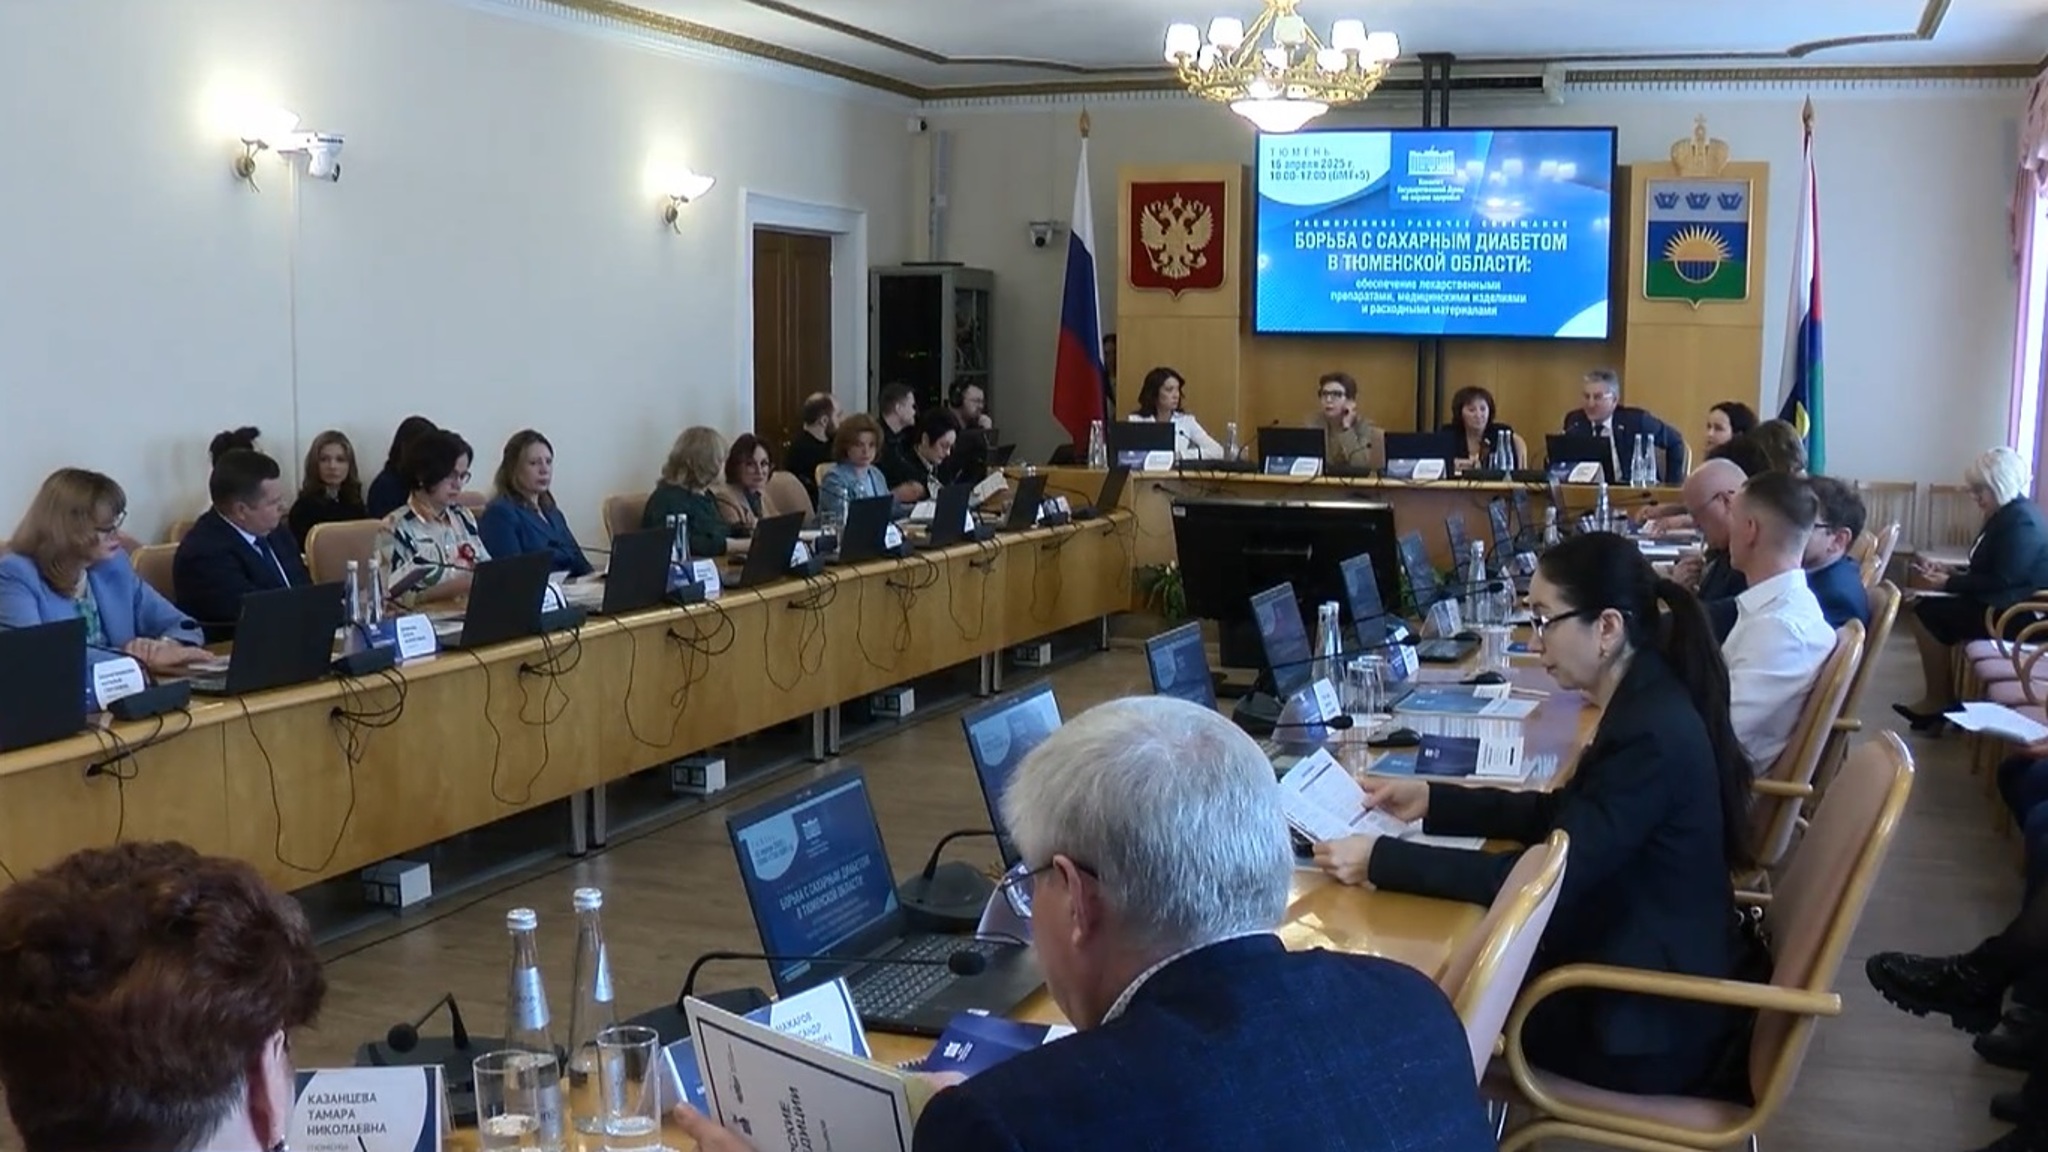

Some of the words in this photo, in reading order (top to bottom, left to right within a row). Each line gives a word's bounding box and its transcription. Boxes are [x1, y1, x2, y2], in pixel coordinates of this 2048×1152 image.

[1320, 158, 1345, 169] 2025
[1295, 231, 1357, 249] БОРЬБА
[1362, 231, 1372, 249] С
[1377, 231, 1470, 250] САХАРНЫМ
[1475, 232, 1568, 252] ДИАБЕТОМ
[1328, 254, 1339, 271] В
[1342, 250, 1446, 272] ТЮМЕНСКОЙ
[1451, 254, 1532, 273] ОБЛАСТИ:
[1356, 278, 1417, 289] обеспечение
[1419, 280, 1501, 291] лекарственными
[1398, 292, 1470, 304] медицинскими
[1472, 293, 1528, 305] изделиями
[1370, 304, 1430, 316] расходными
[1432, 306, 1498, 318] материалами
[307, 1092, 377, 1105] КАЗАНЦЕВА
[308, 1108, 356, 1120] ТАМАРА
[307, 1123, 387, 1135] НИКОЛАЕВНА
